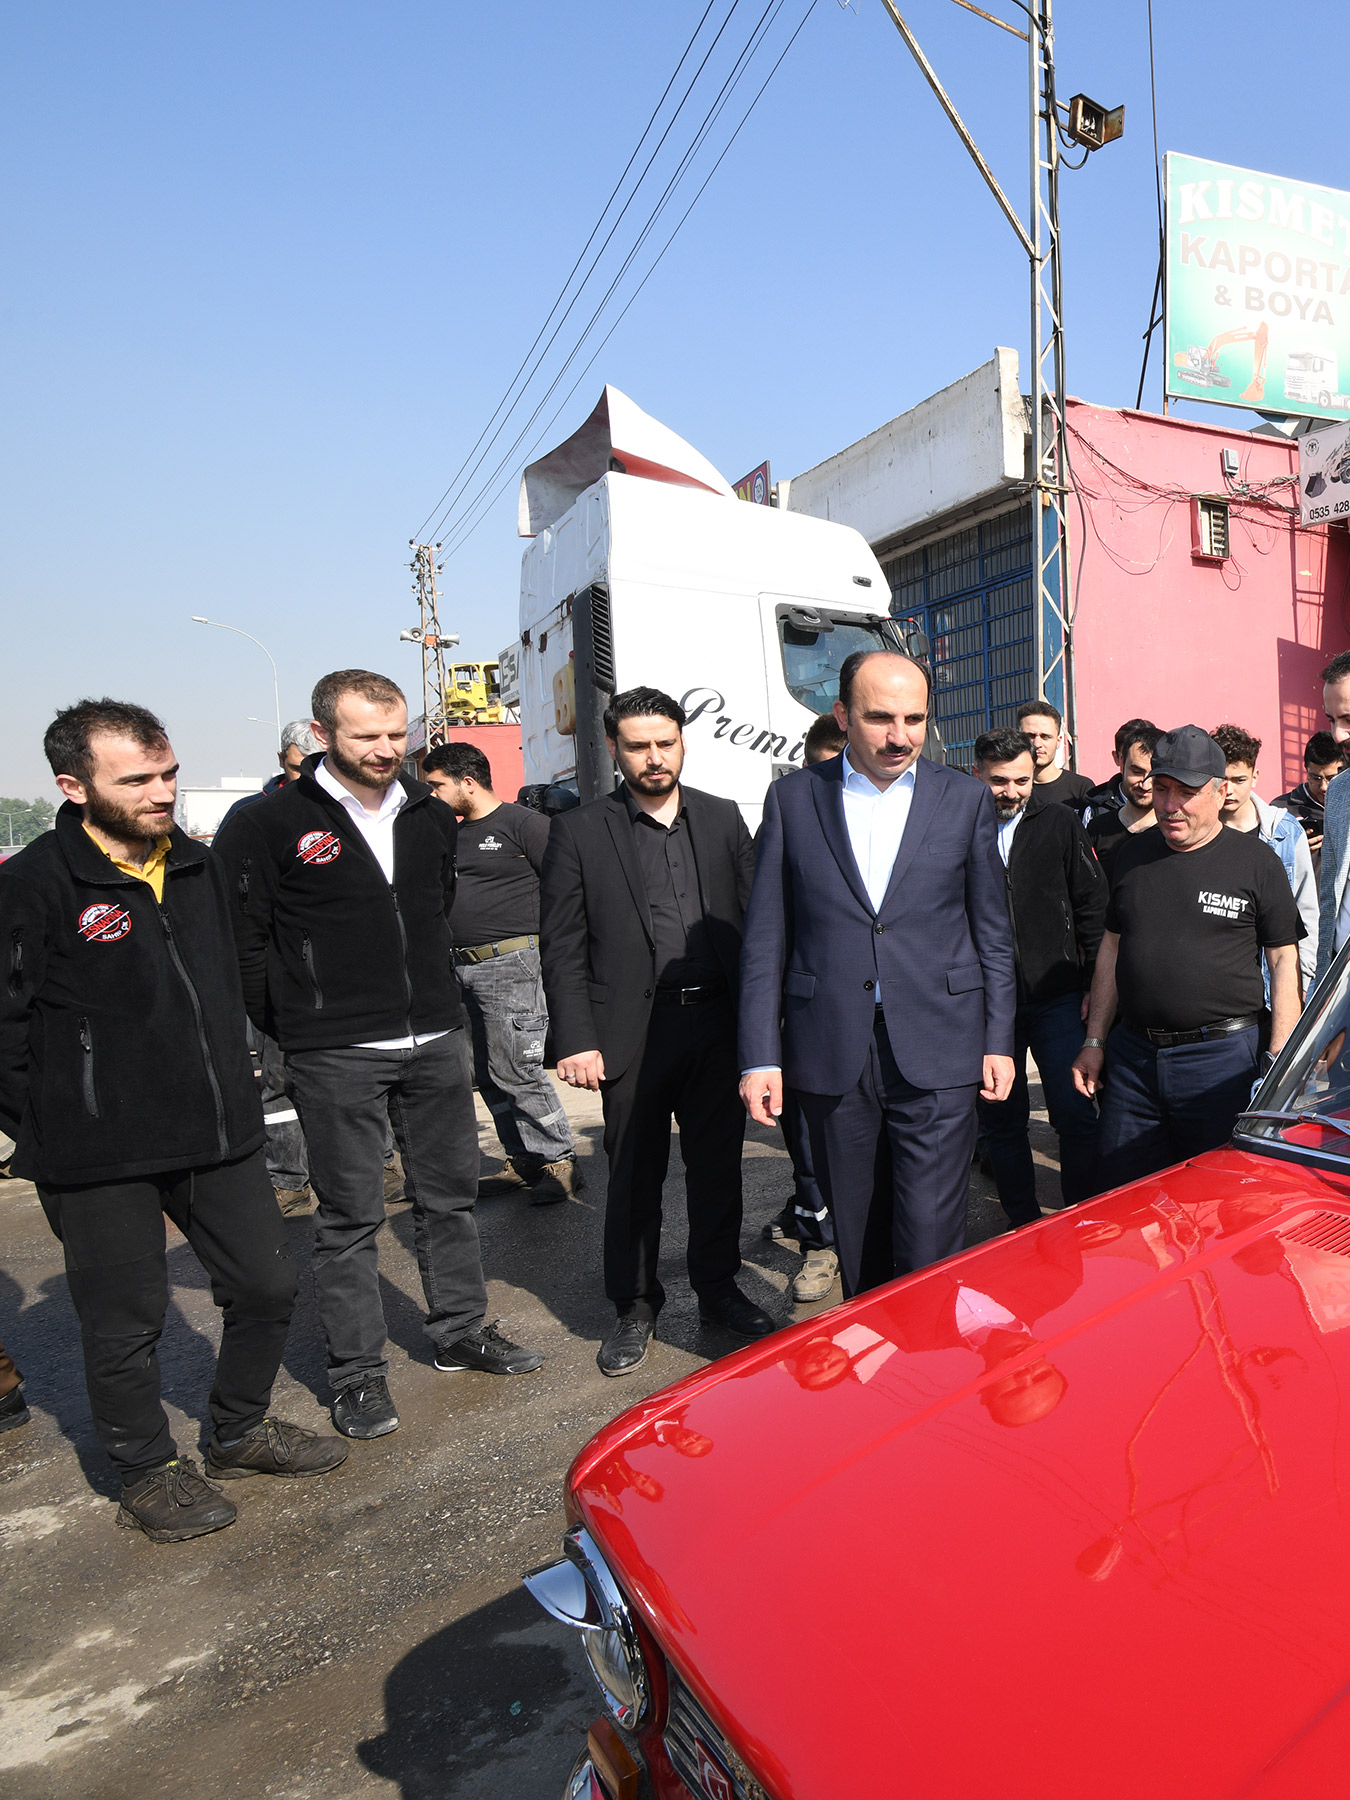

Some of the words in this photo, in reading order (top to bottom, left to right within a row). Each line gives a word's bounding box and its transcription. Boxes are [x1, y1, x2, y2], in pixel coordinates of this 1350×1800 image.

[1214, 285, 1233, 307] &
[1245, 286, 1335, 326] BOYA
[1309, 505, 1330, 520] 0535
[1334, 500, 1350, 514] 428
[679, 687, 806, 762] Premi
[1198, 891, 1249, 912] KISMET
